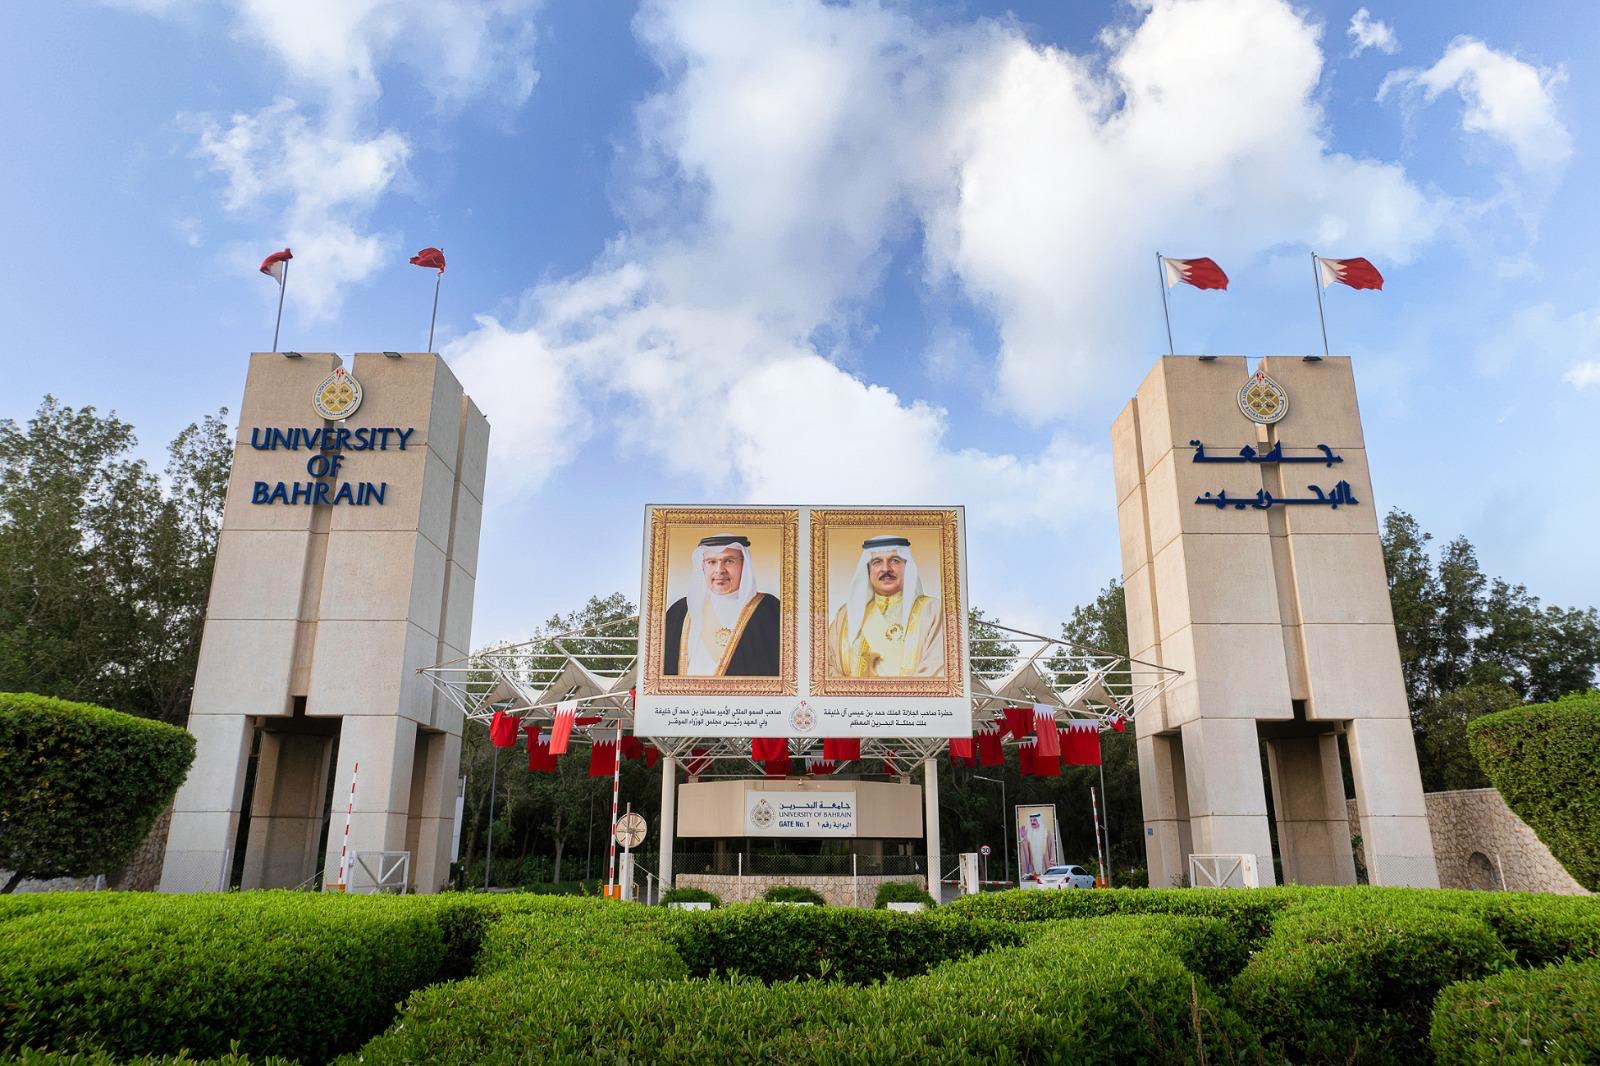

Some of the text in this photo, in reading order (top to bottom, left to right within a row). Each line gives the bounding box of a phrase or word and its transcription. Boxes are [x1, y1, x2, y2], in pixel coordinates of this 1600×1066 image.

[251, 427, 414, 450] UNIVERSITY
[1189, 439, 1344, 468] جامعة
[307, 455, 345, 478] OF
[251, 481, 387, 505] BAHRAIN
[1195, 479, 1359, 510] البحرين
[655, 707, 671, 717] خليفة
[691, 708, 699, 717] بن
[700, 708, 716, 717] سلمان
[732, 708, 748, 719] الملكي
[748, 708, 763, 717] السمو
[765, 708, 782, 718] صاحب
[823, 708, 840, 718] خليفة
[848, 710, 864, 718] عيسى
[865, 709, 873, 718] بن
[902, 709, 919, 718] الجلالة
[920, 709, 936, 719] صاحب
[937, 709, 953, 718] حضرة
[689, 717, 704, 727] الوزراء
[706, 718, 721, 727] مجلس
[723, 717, 742, 727] رئيس
[743, 718, 757, 727] العهد
[759, 719, 768, 728] ولي
[850, 719, 870, 728] المعظم
[871, 719, 894, 728] البحرين
[779, 801, 851, 810] جامعة البحرين
[821, 821, 832, 830] رقم
[833, 821, 852, 830] البوابة
